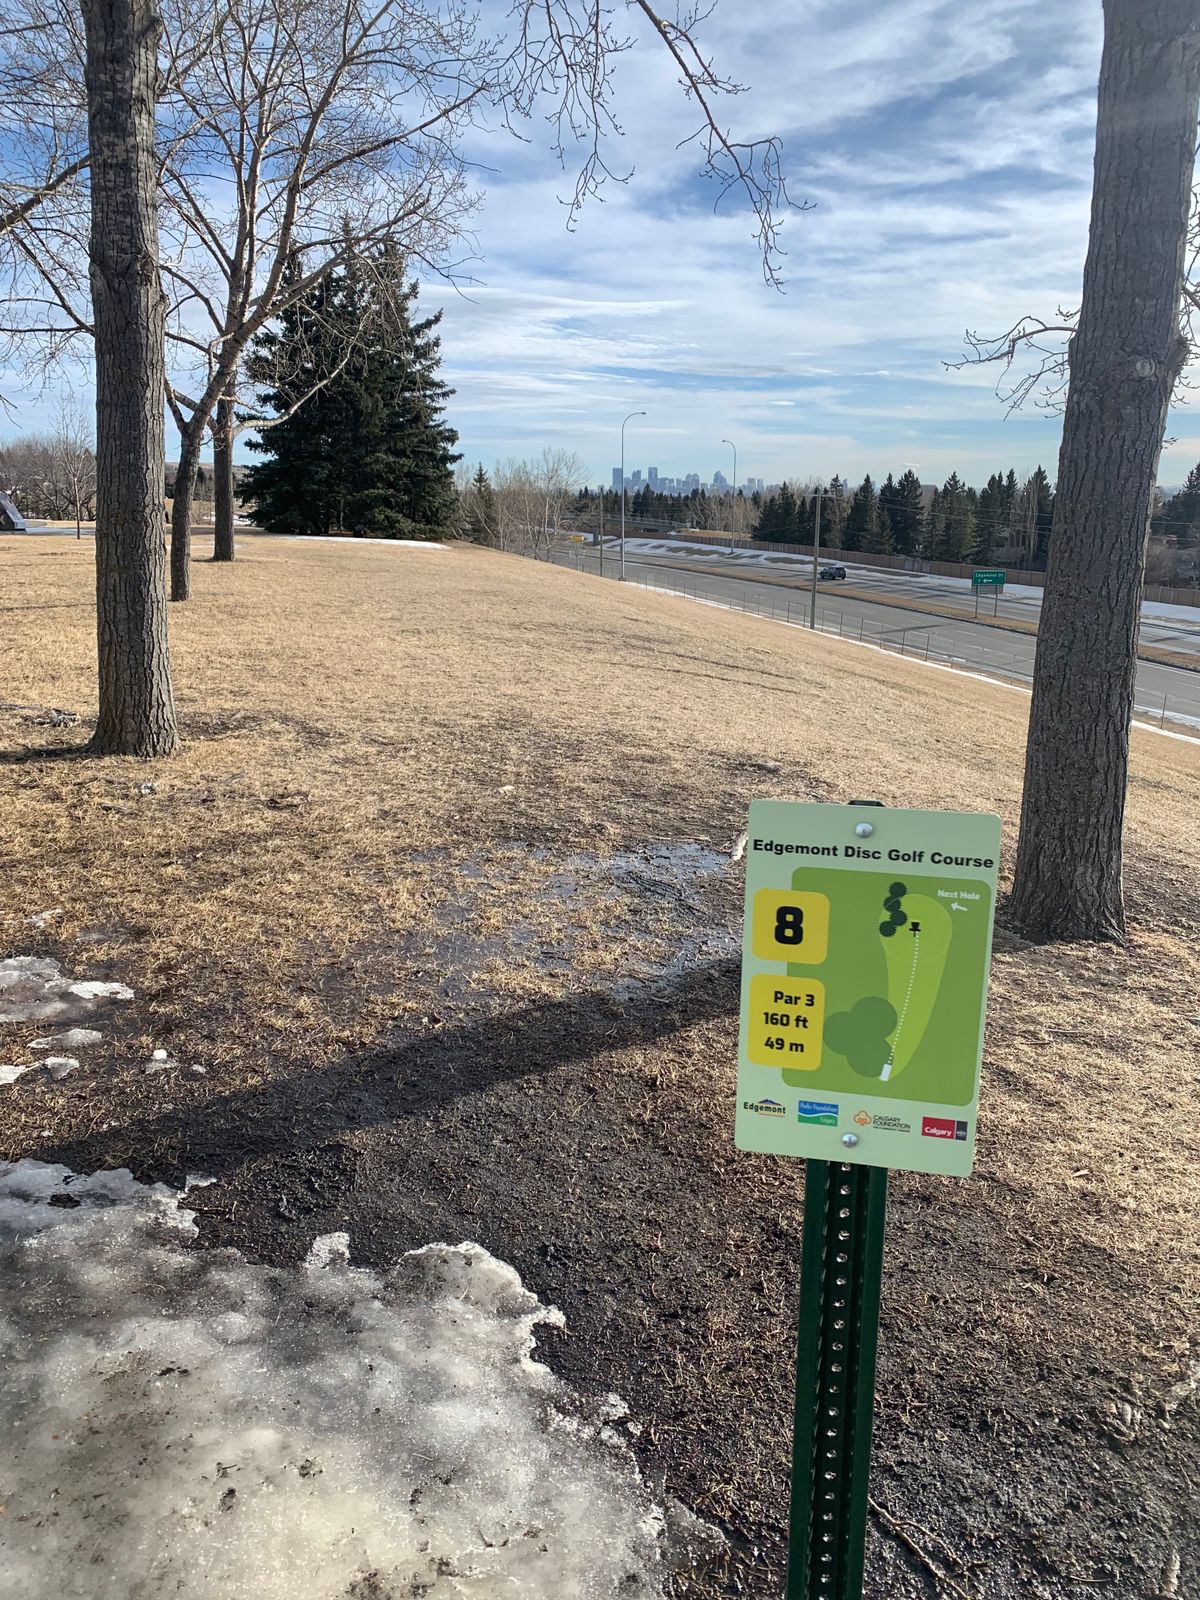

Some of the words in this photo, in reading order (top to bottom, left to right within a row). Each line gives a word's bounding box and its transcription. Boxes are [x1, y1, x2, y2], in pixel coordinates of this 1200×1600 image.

[753, 839, 838, 857] Edgemont
[844, 846, 881, 860] Disc
[888, 849, 925, 863] Golf
[930, 852, 994, 868] Course
[937, 889, 958, 899] Next
[959, 891, 980, 900] Hole
[774, 905, 804, 945] 8
[773, 990, 801, 1006] Par
[804, 994, 815, 1007] 3
[763, 1012, 790, 1027] 160
[794, 1015, 808, 1029] ft
[764, 1036, 785, 1051] 49
[789, 1041, 805, 1053] m
[743, 1101, 786, 1114] Edgemont
[872, 1120, 911, 1129] FOUNDATION
[873, 1114, 901, 1122] CALGARY
[924, 1126, 952, 1137] Calgary
